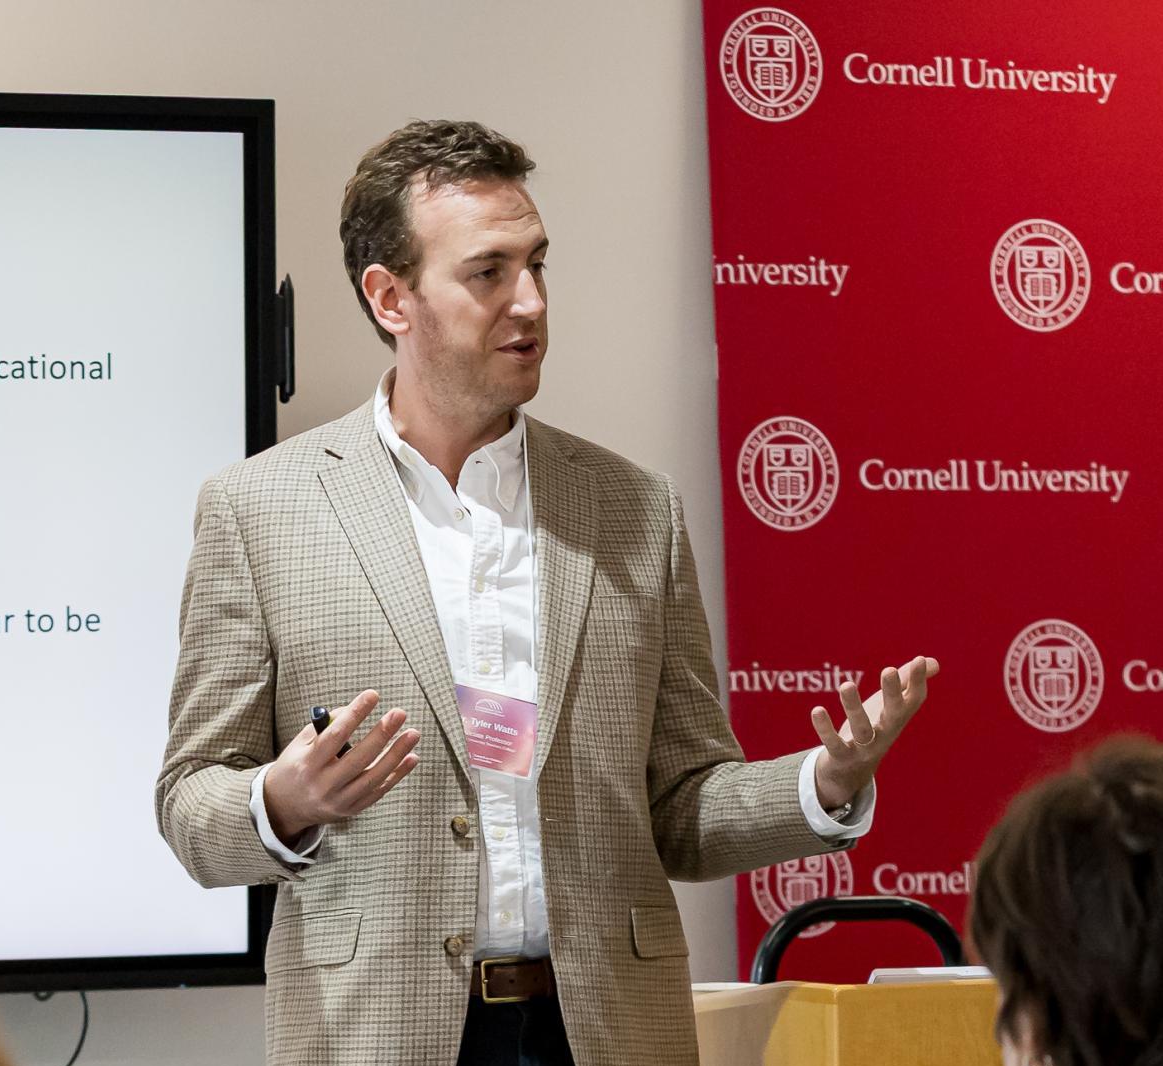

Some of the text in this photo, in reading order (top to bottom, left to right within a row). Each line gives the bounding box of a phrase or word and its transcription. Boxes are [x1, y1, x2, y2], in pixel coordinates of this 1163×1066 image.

[843, 52, 1118, 105] Cornell University
[713, 254, 850, 297] niversity
[859, 458, 1129, 503] Cornell University
[23, 609, 55, 634] to
[65, 605, 101, 633] be
[729, 662, 865, 692] niversity
[471, 717, 492, 728] Tyler
[494, 723, 518, 736] Watts
